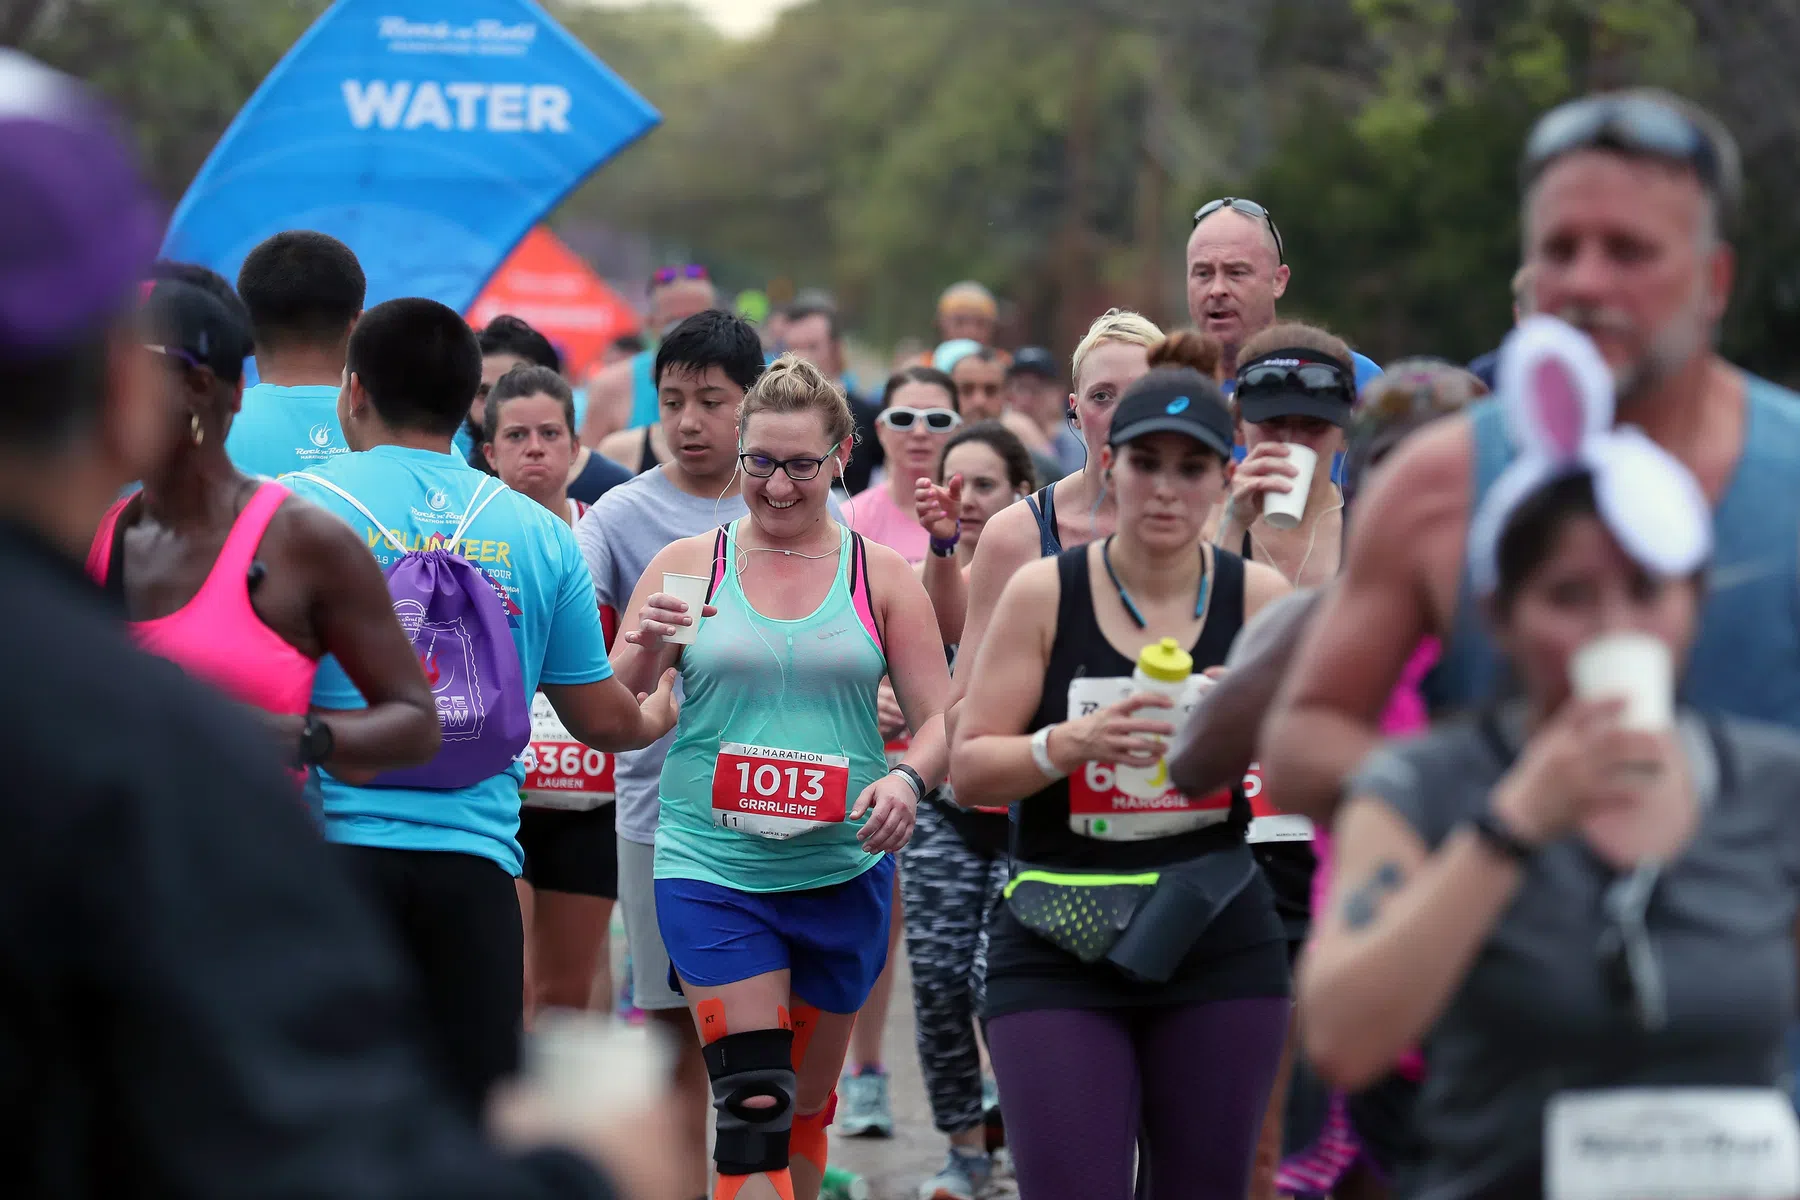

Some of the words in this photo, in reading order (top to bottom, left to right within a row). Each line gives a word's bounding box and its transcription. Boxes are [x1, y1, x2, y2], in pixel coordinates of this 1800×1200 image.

[342, 79, 573, 132] WATER
[410, 505, 436, 519] Rock
[367, 525, 512, 569] VOLUNTEER
[488, 568, 512, 580] TOUR
[742, 746, 758, 756] 1/2
[762, 748, 823, 762] MARATHON
[537, 777, 584, 789] LAUREN
[736, 762, 825, 801] 1013
[739, 799, 817, 816] GRRRLIEME
[705, 1015, 715, 1024] KT
